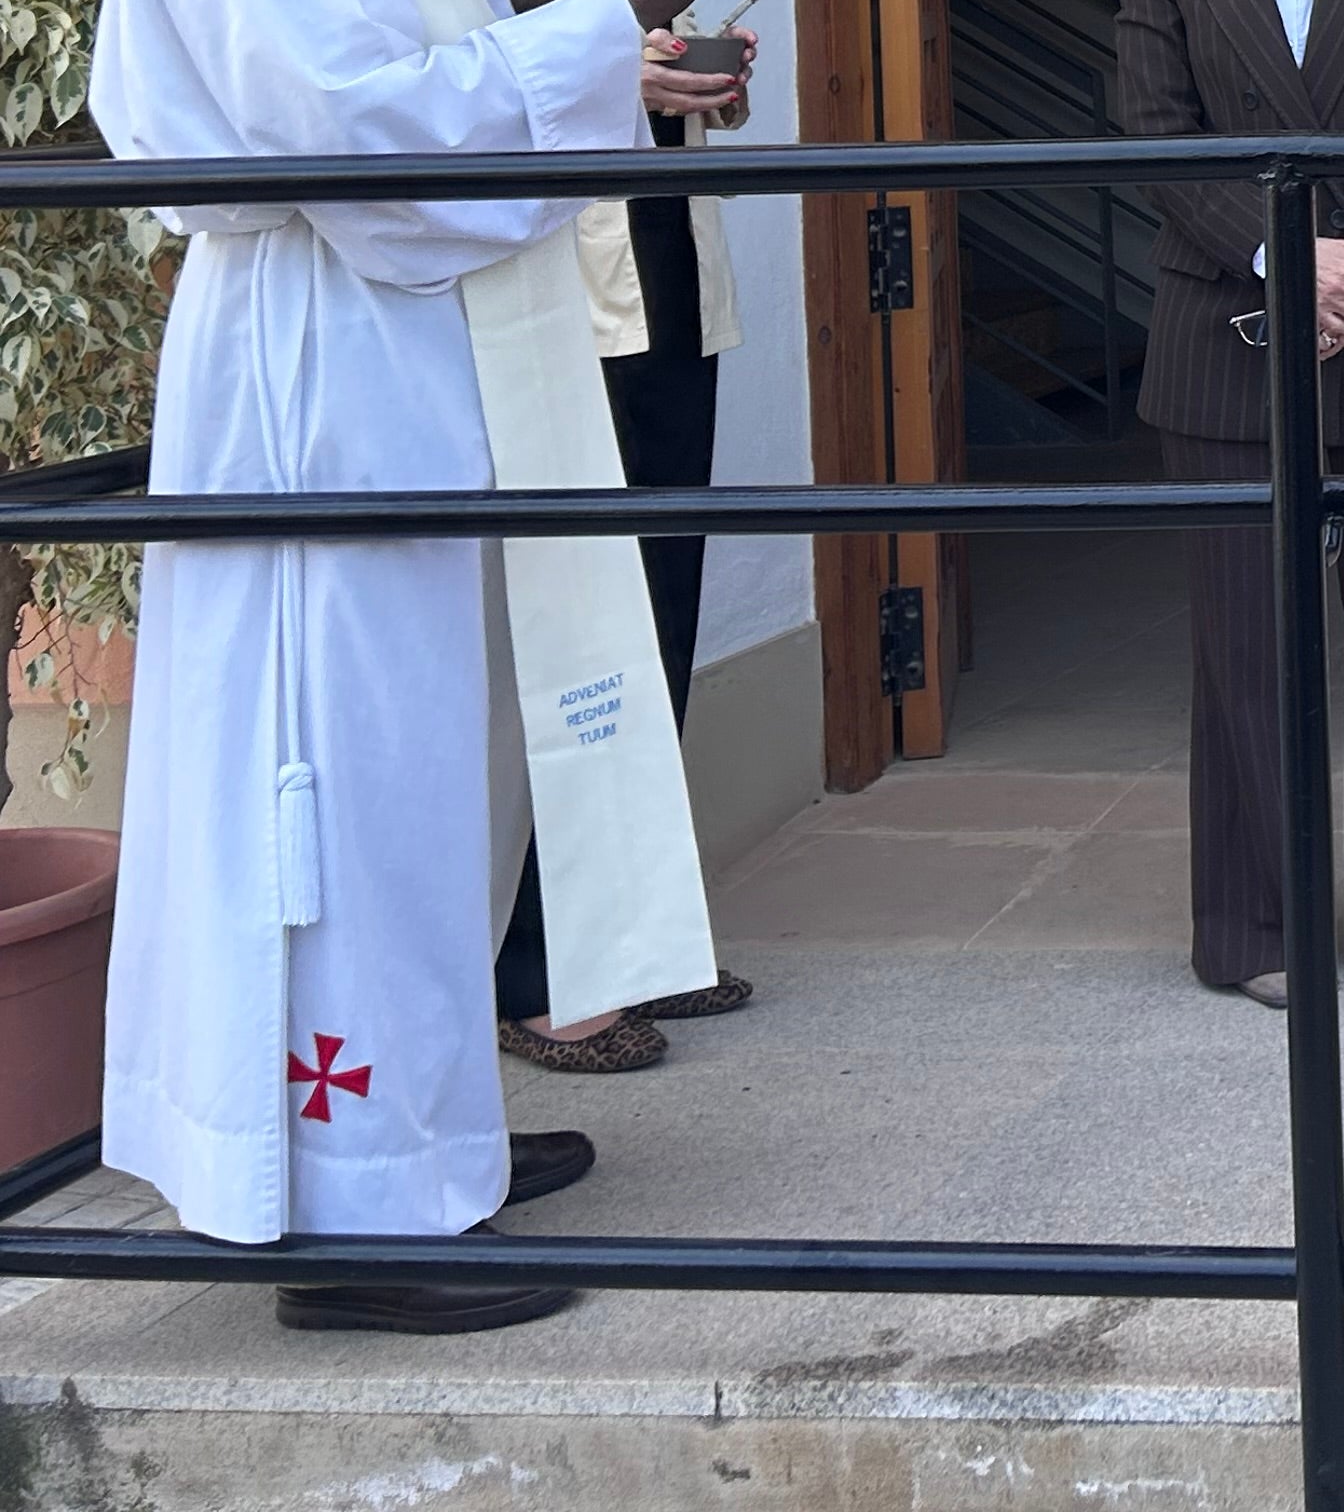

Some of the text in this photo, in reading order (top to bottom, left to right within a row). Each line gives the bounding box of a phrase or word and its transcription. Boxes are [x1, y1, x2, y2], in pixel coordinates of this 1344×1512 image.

[559, 672, 624, 708] ADVENIAT
[566, 697, 622, 728] REGNUM
[578, 723, 617, 745] TUUM
